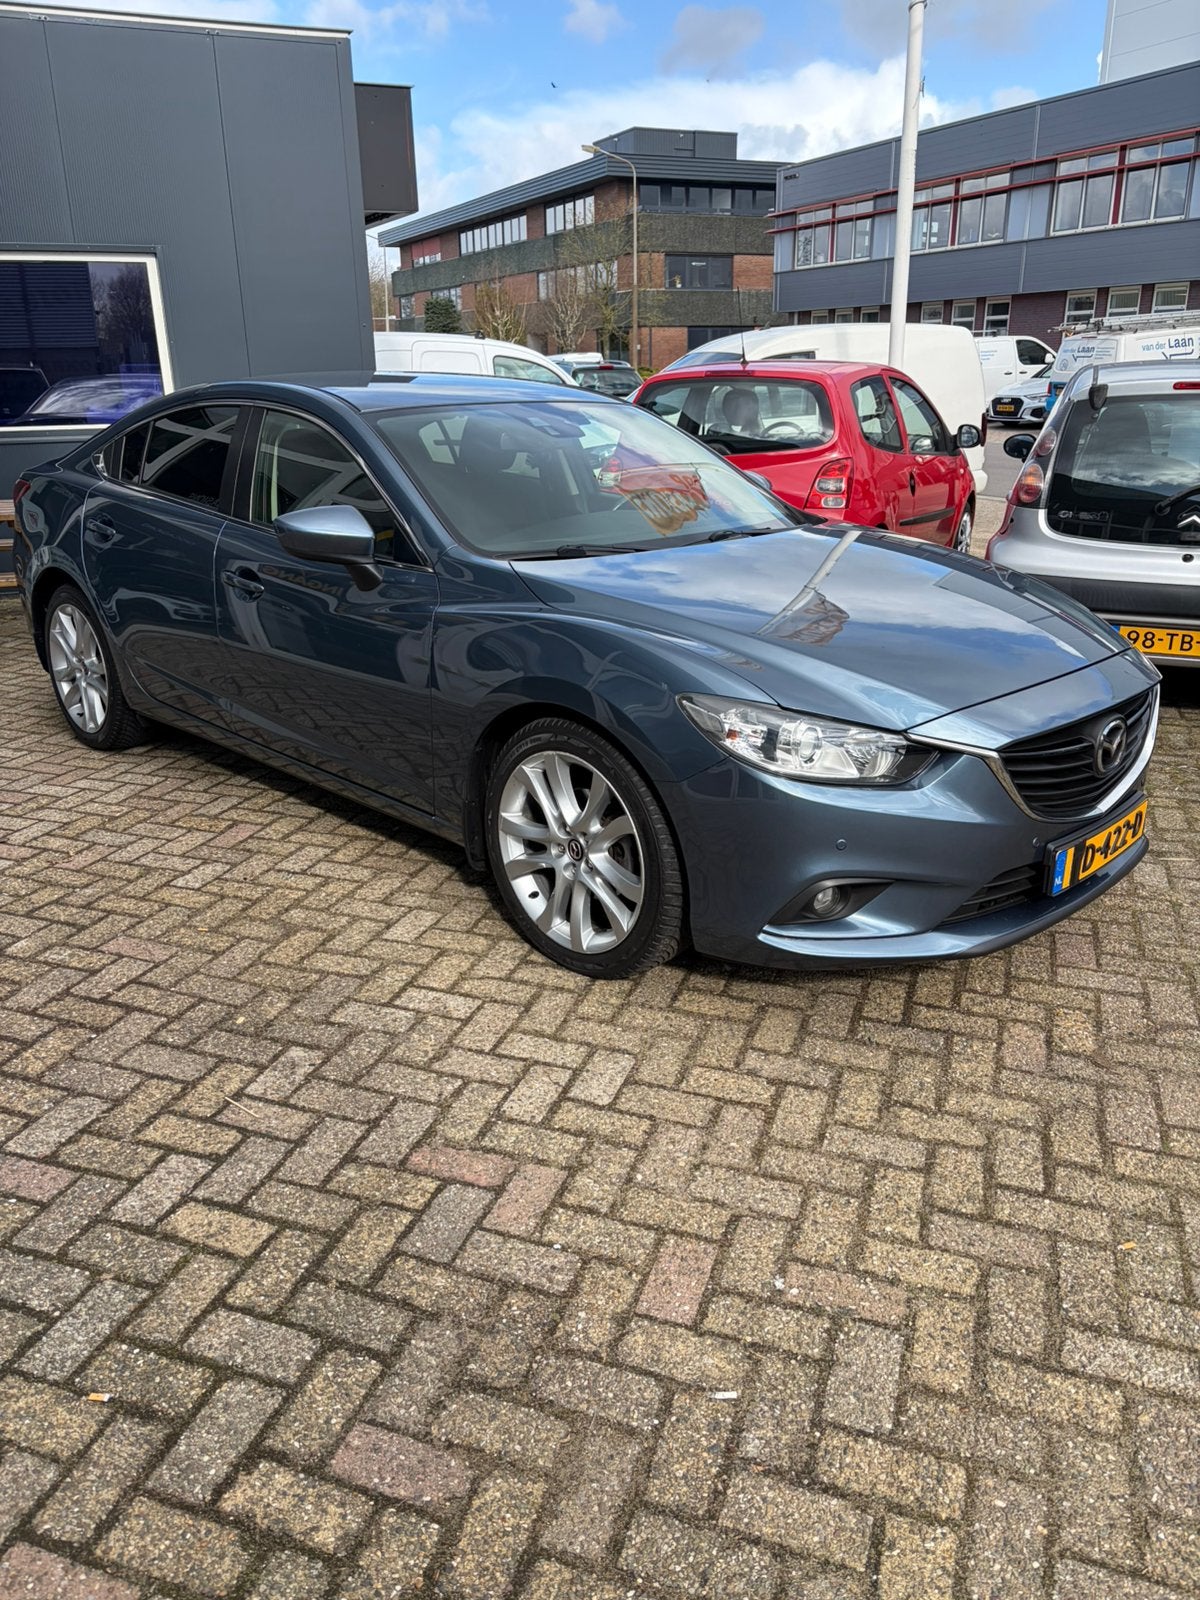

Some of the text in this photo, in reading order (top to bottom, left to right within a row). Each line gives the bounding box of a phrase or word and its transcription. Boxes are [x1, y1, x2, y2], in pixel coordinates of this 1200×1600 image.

[1141, 343, 1155, 351] van
[1155, 341, 1167, 350] der
[1167, 336, 1194, 349] Laan
[1054, 876, 1062, 886] NL
